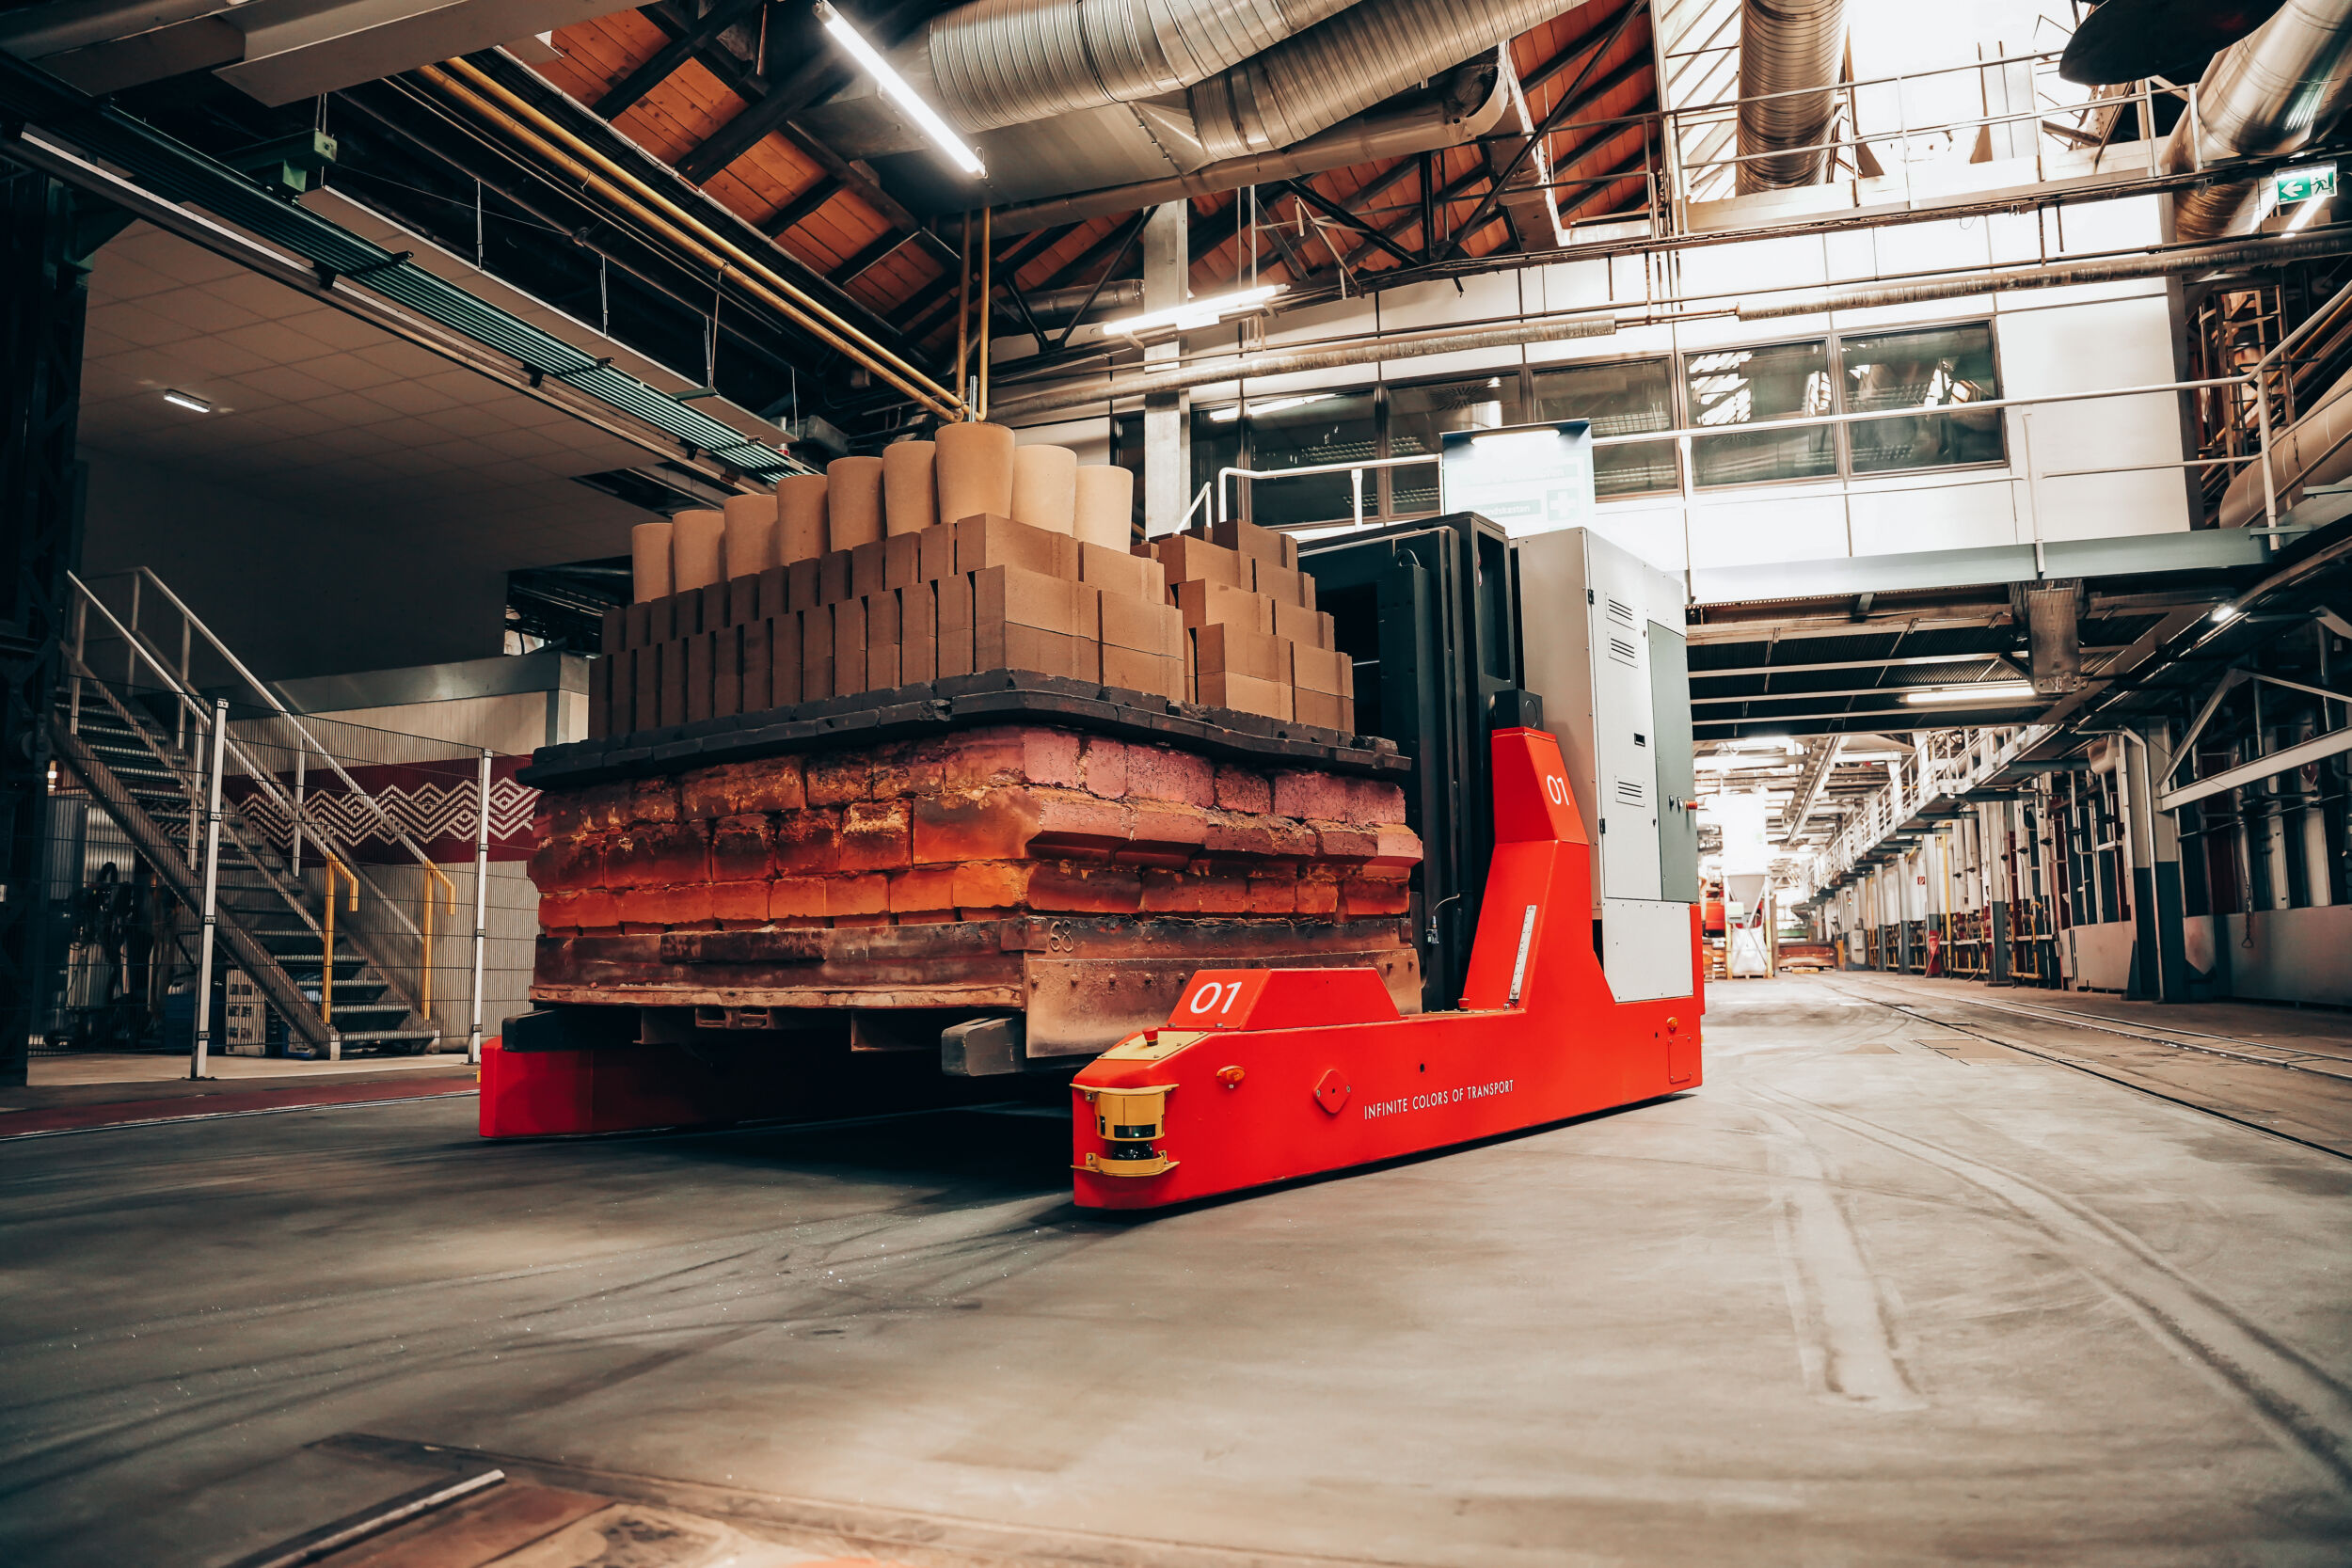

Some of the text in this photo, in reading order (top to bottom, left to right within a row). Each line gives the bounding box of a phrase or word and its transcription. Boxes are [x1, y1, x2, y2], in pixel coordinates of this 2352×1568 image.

[1546, 774, 1570, 806] 01
[1189, 981, 1243, 1014] 01
[1364, 1079, 1514, 1119] INFINITE COLORS OF TRANSPORT
